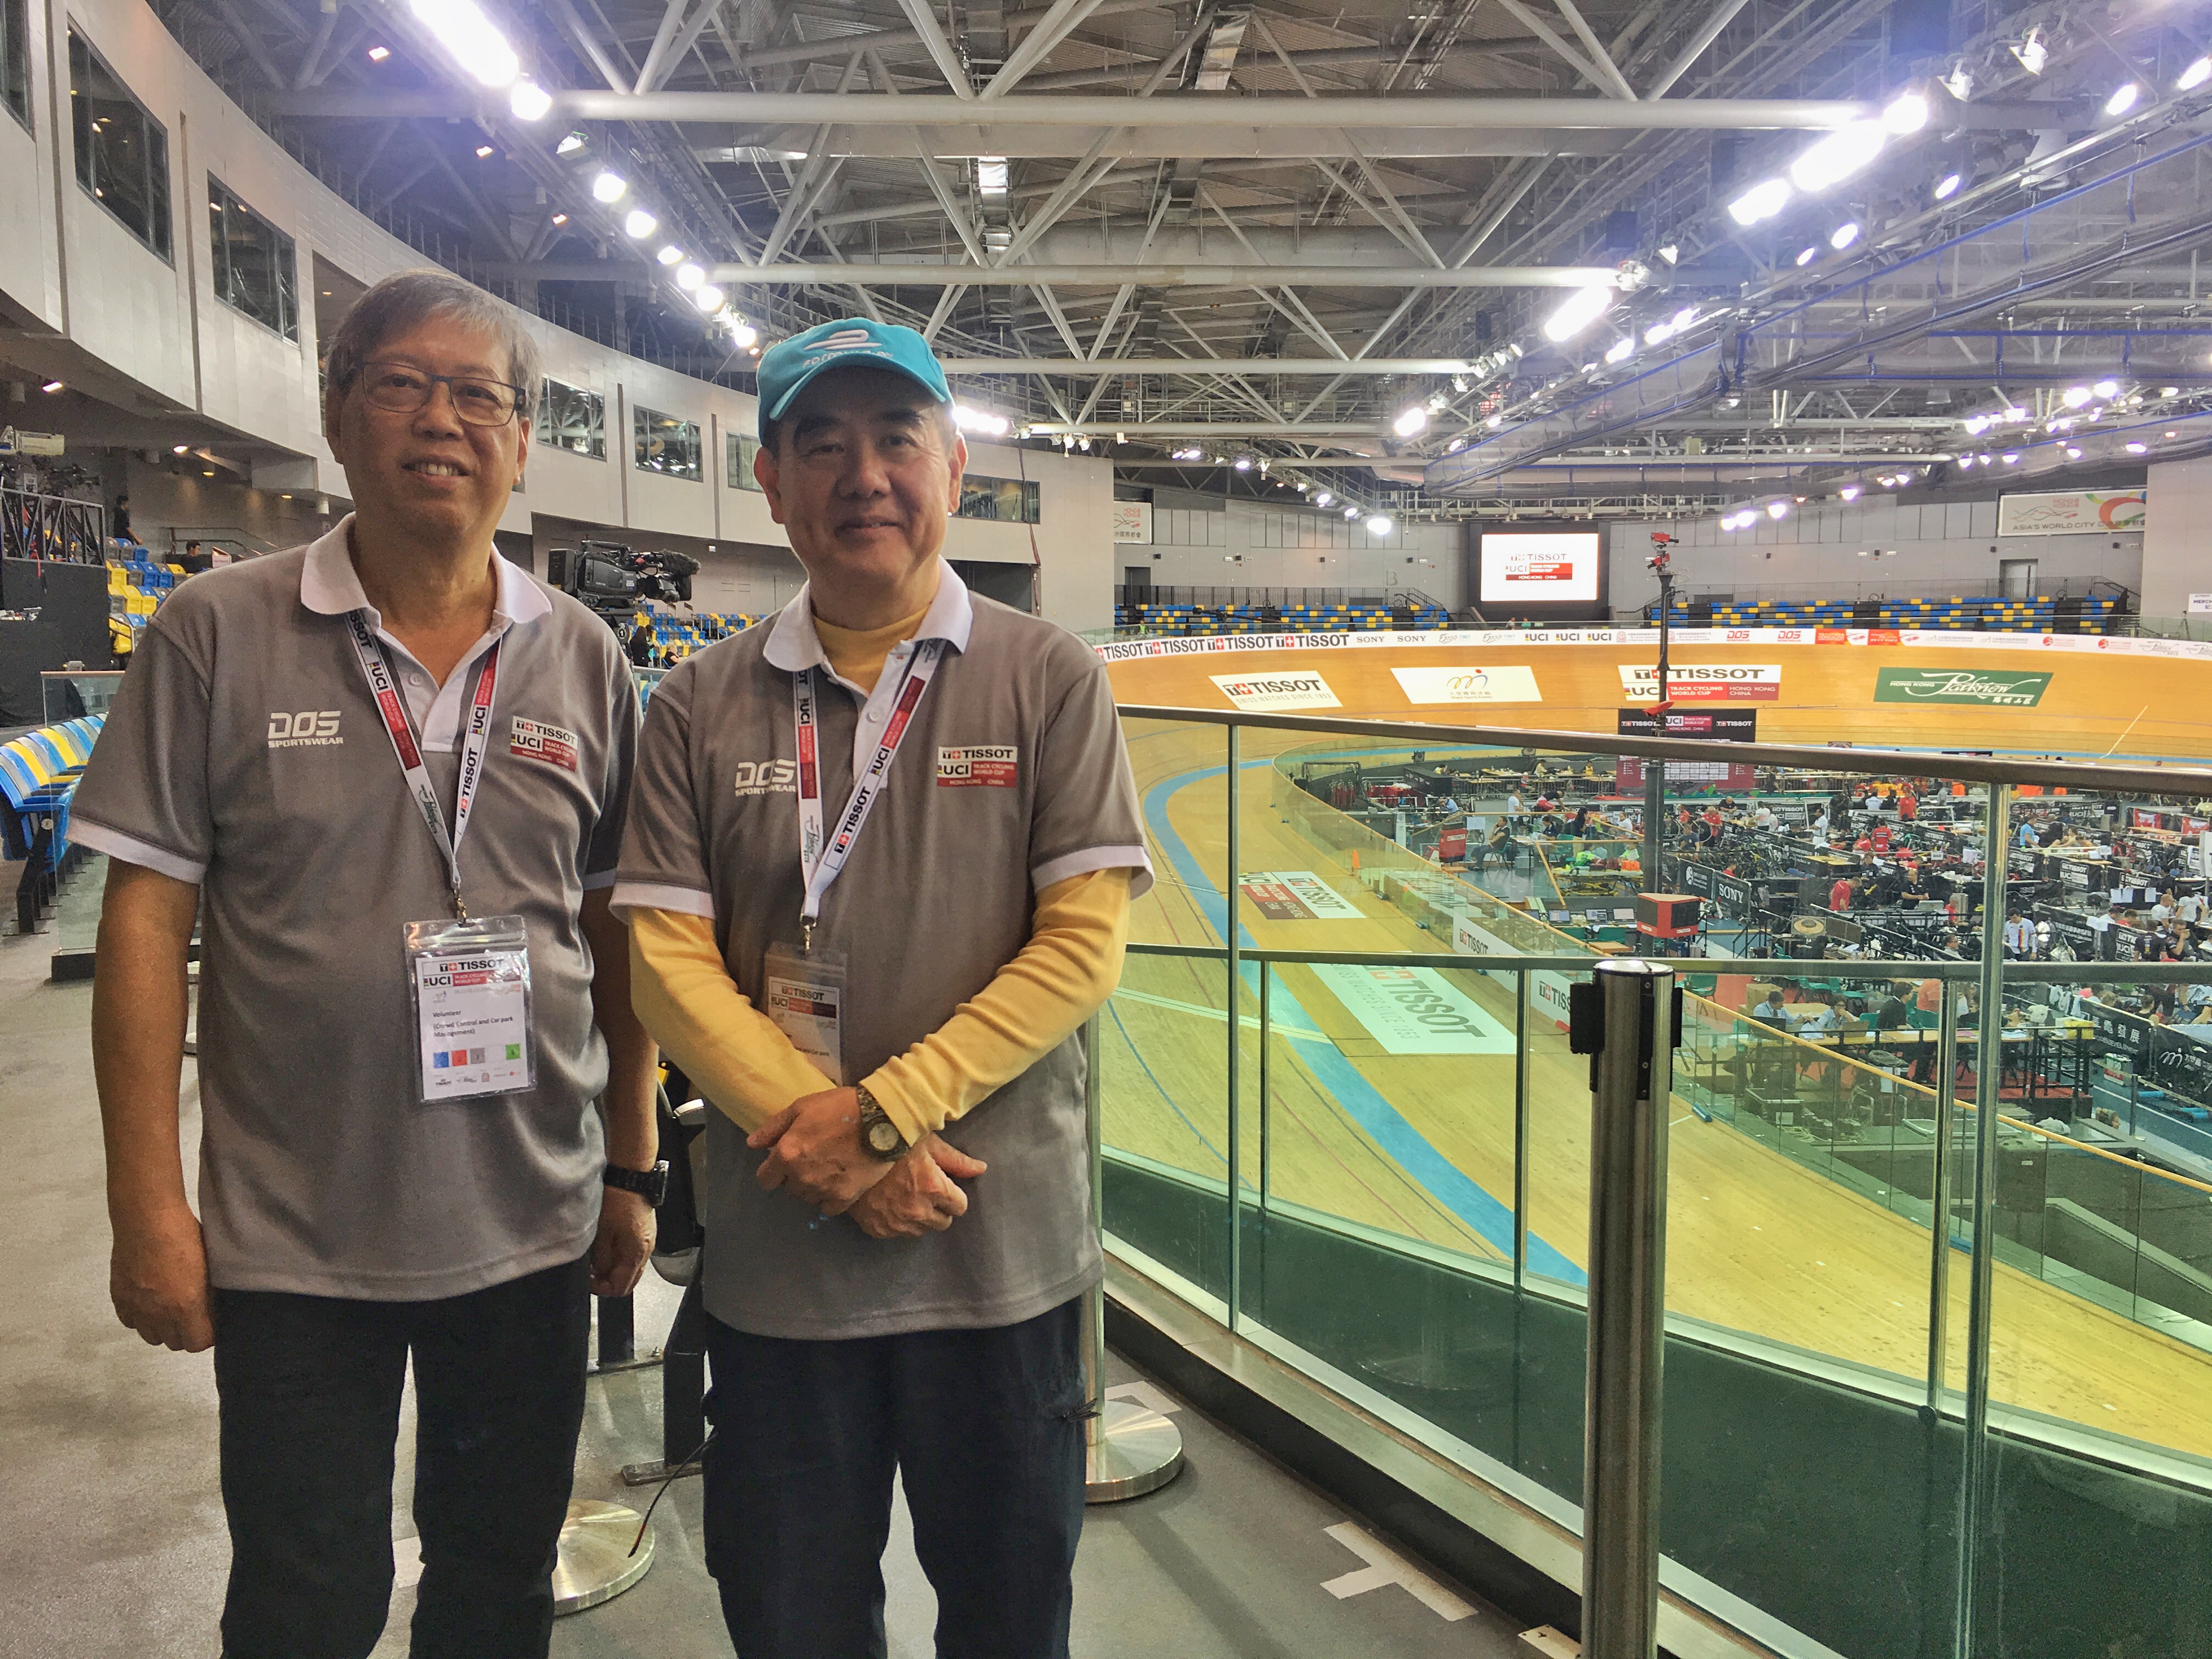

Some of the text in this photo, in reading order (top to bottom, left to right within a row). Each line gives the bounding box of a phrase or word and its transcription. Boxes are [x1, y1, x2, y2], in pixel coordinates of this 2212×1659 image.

[1224, 636, 1273, 650] TISSOT
[1295, 634, 1350, 647] TISSOT
[1530, 633, 1548, 641] UCI
[1560, 633, 1580, 641] UCI
[1103, 643, 1143, 659] TISSOT
[1161, 639, 1205, 653] TISSOT
[371, 667, 388, 691] UCI
[1669, 669, 1765, 679] TISSOT
[1247, 680, 1321, 693] TISSOT
[1631, 687, 1660, 696] UC
[473, 707, 486, 730] UCI
[800, 703, 810, 724] UCI
[268, 711, 341, 737] DOS
[517, 735, 540, 748] UCI
[535, 724, 575, 744] TISSOT
[268, 737, 343, 748] SPORTSWEAR
[875, 748, 890, 771] UCI
[962, 749, 1013, 759] TISSOT
[462, 748, 477, 797] TISSOT
[735, 759, 796, 788] DOS
[944, 765, 969, 775] UCI
[842, 786, 871, 833] TISSOT
[1296, 886, 1347, 909] TISSOT
[1718, 883, 1743, 904] SONY
[1468, 933, 1488, 954] TISSOT
[458, 959, 504, 970] TISSOT
[429, 976, 451, 986] UCI
[794, 988, 825, 1000] TISSOT
[1551, 987, 1570, 1014] TISS
[1347, 979, 1385, 1004] WATCHES
[1371, 1005, 1406, 1023] SINCE
[1389, 1025, 1420, 1039] 1853
[1381, 980, 1487, 1037] TISSOT
